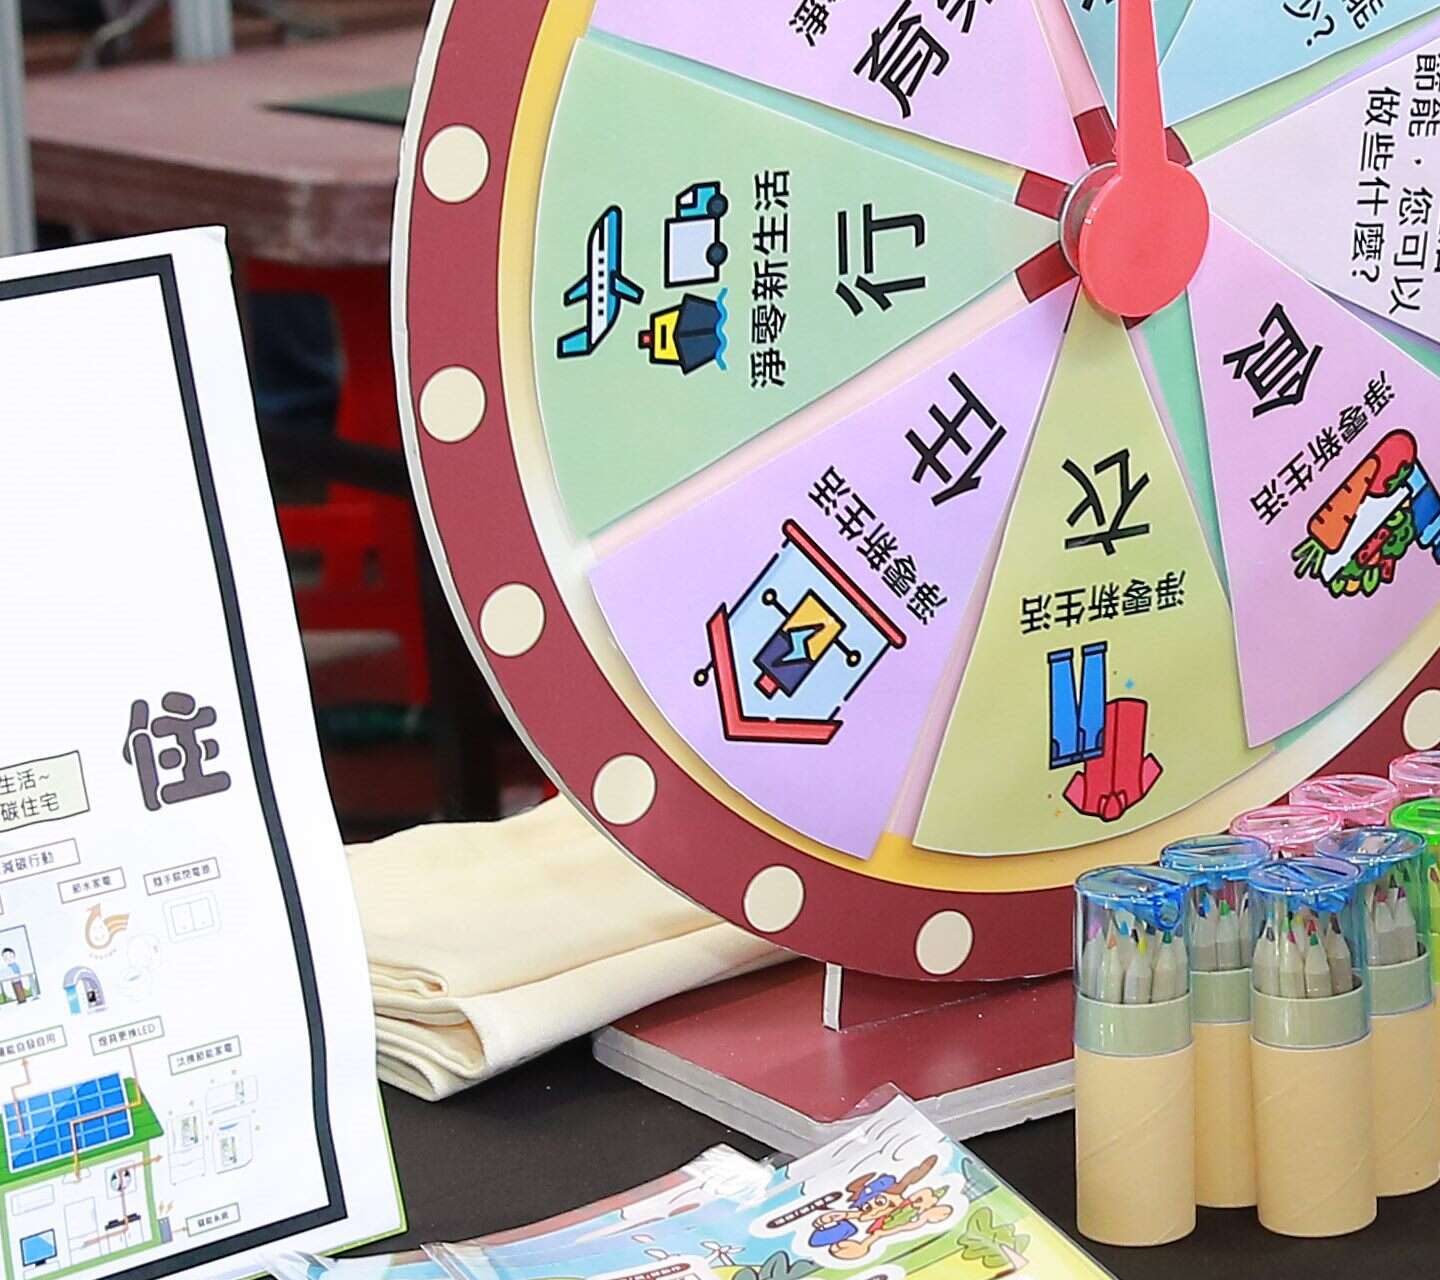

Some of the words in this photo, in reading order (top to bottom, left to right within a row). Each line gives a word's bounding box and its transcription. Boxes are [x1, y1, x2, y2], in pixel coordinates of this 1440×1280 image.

[750, 169, 790, 387] 淨零新生活
[834, 203, 926, 315] 行
[1223, 303, 1324, 419] 食
[904, 372, 1007, 507] 住
[1251, 370, 1396, 525] 淨零新生活
[808, 465, 949, 626] 淨零新生活
[1062, 449, 1150, 555] 衣
[1019, 569, 1185, 636] 淨零新生活
[122, 690, 232, 812] 住
